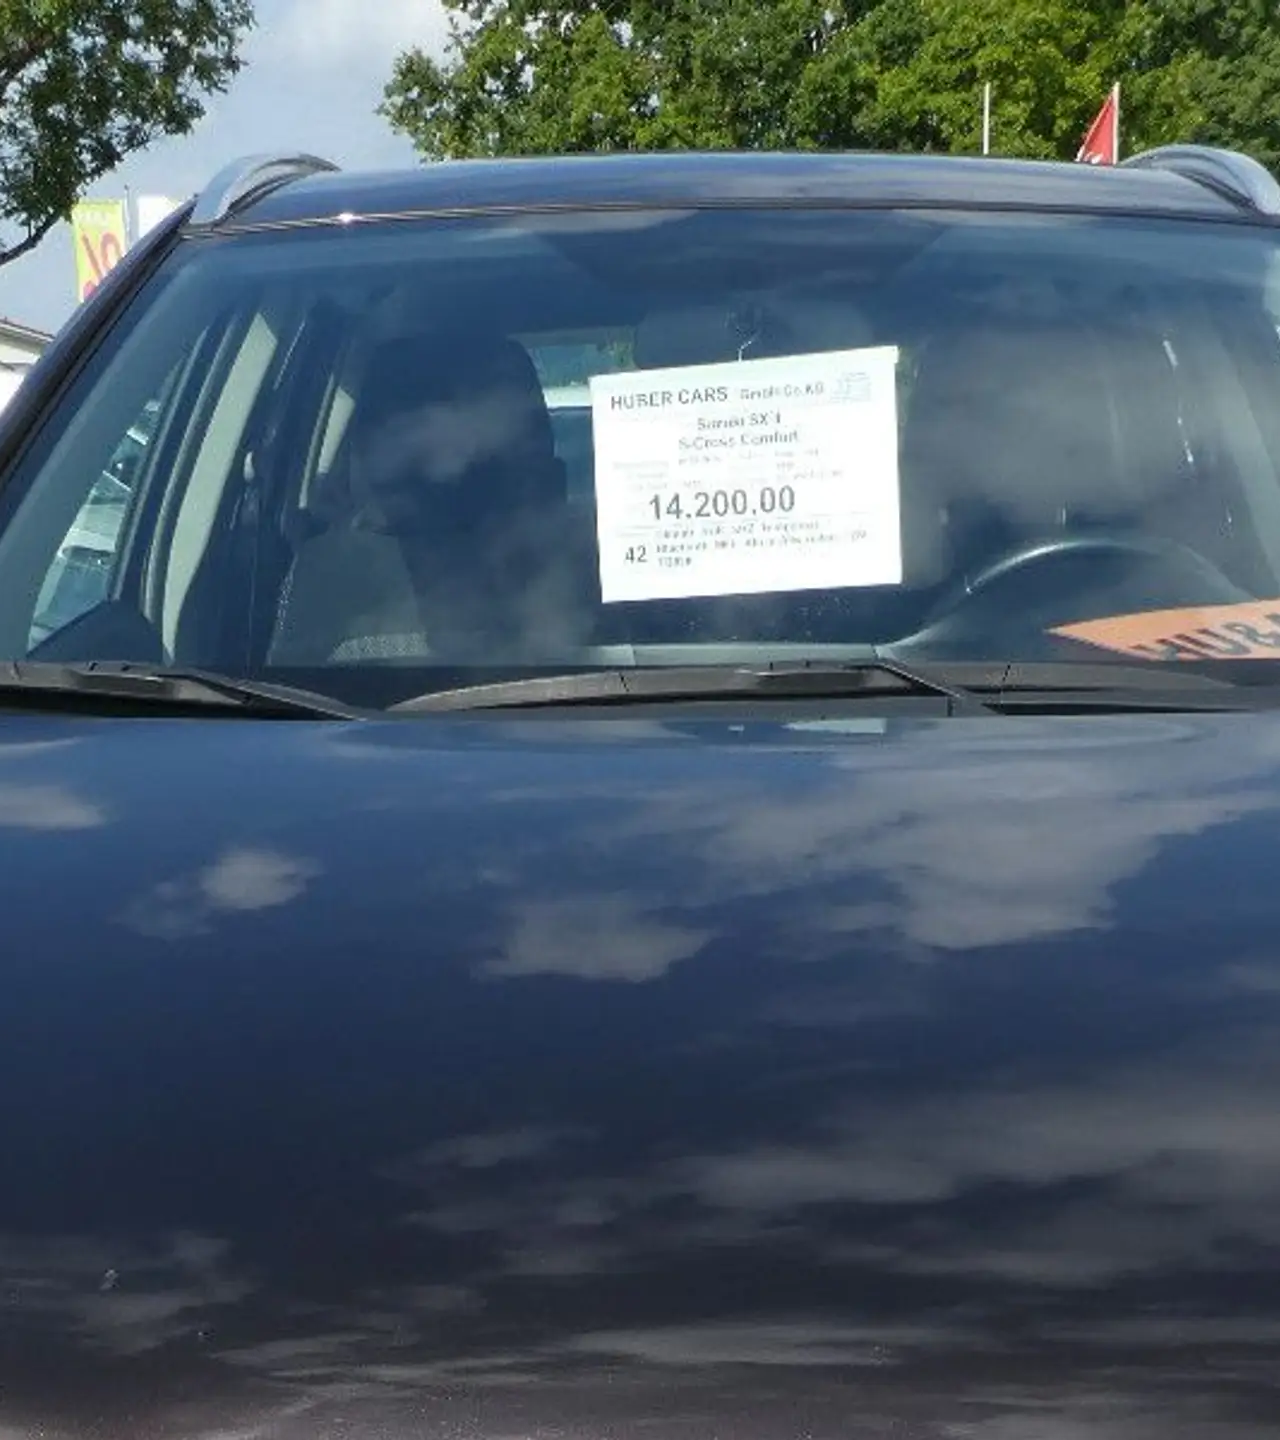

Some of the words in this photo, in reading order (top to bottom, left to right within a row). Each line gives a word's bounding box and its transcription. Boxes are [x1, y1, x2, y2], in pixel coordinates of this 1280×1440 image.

[610, 391, 672, 411] HUBER
[678, 386, 728, 405] CARS
[625, 545, 648, 565] 42
